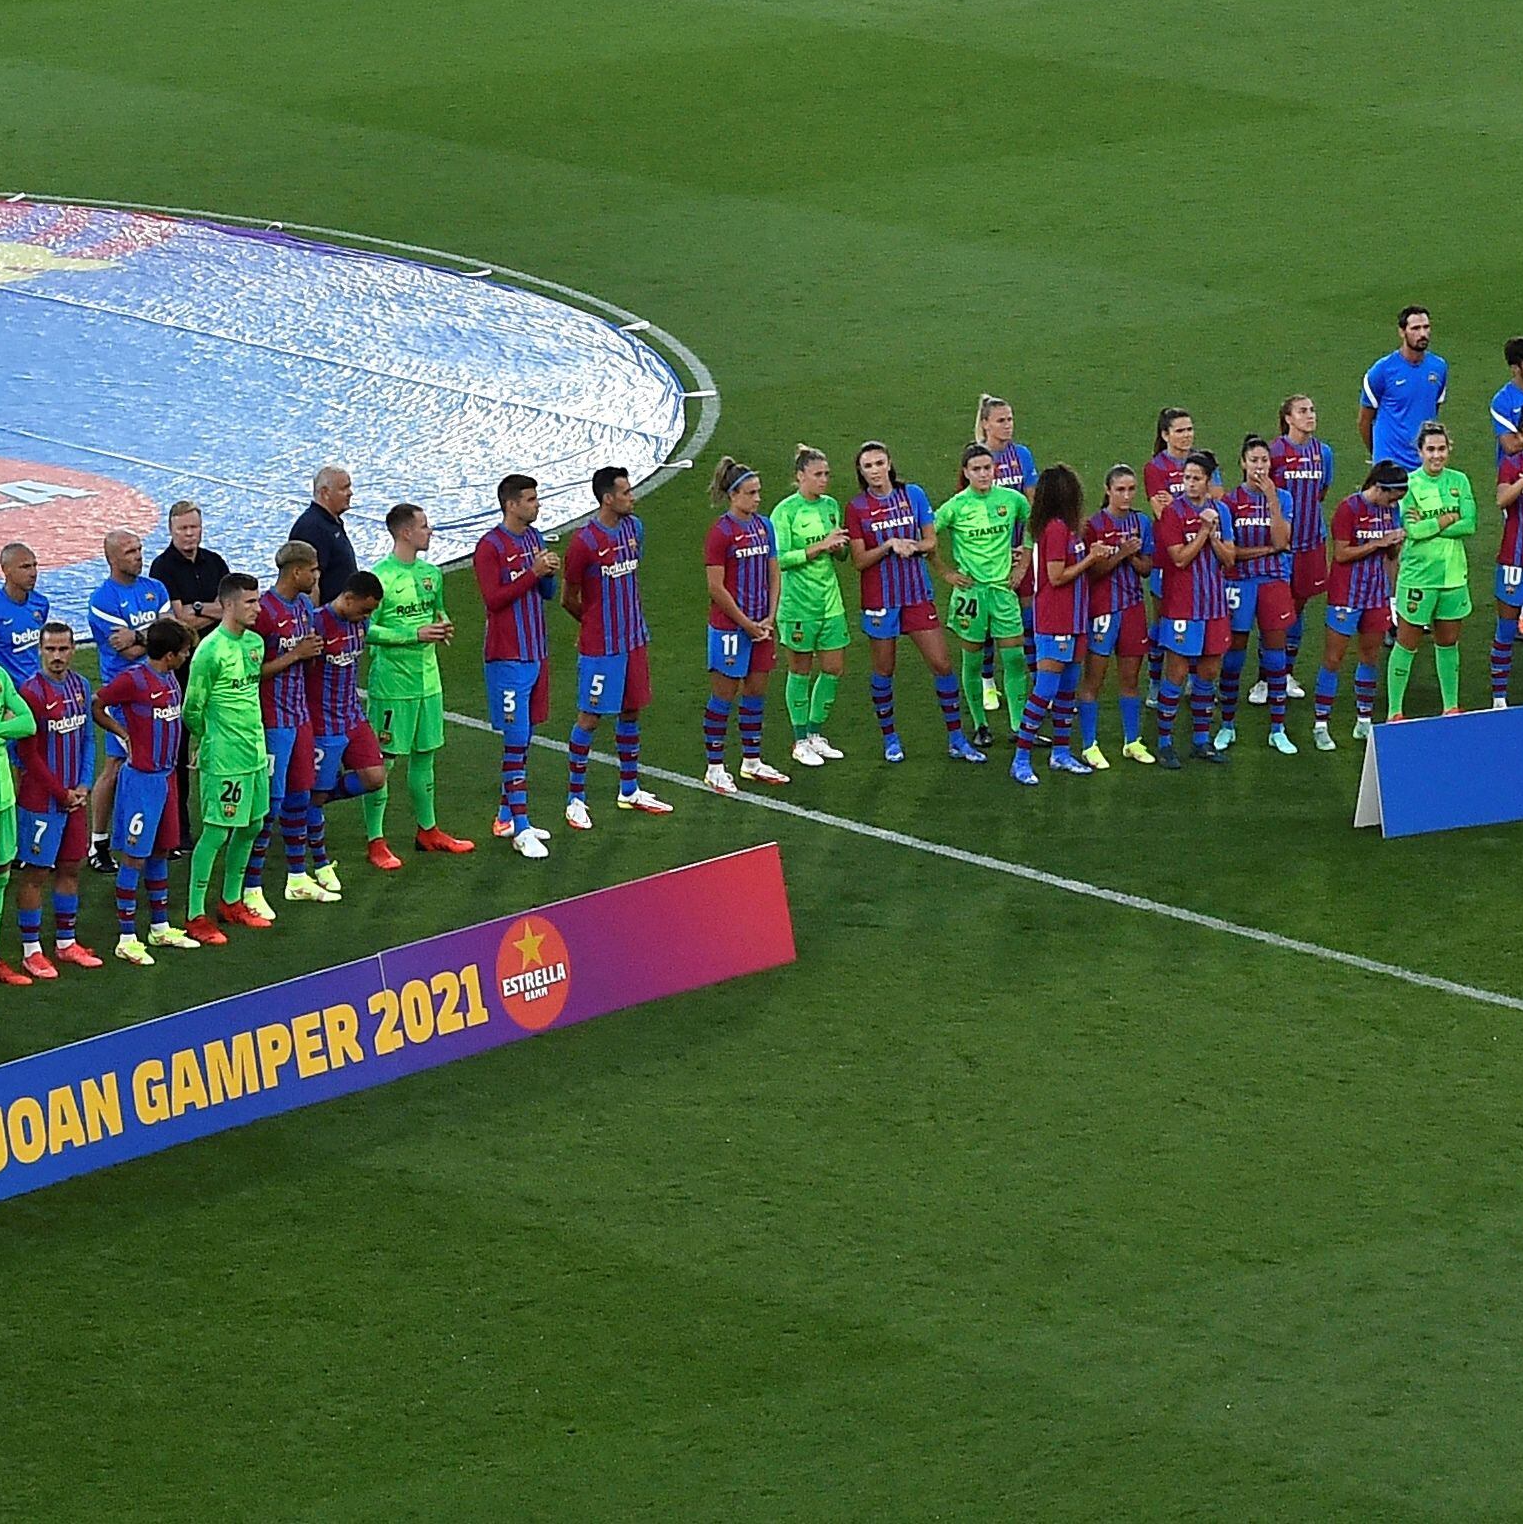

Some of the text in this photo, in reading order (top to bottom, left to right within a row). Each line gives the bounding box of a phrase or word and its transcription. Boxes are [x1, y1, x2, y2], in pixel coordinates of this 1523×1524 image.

[1502, 565, 1523, 586] 10
[954, 596, 978, 619] 24
[721, 634, 738, 656] 11
[590, 675, 605, 697] 5
[503, 691, 516, 713] 3
[220, 780, 242, 803] 26
[34, 820, 48, 844] 7
[128, 813, 143, 836] 6
[502, 962, 567, 999] ESTRELLA
[132, 1002, 364, 1126] GAMPER
[367, 963, 489, 1056] 2021
